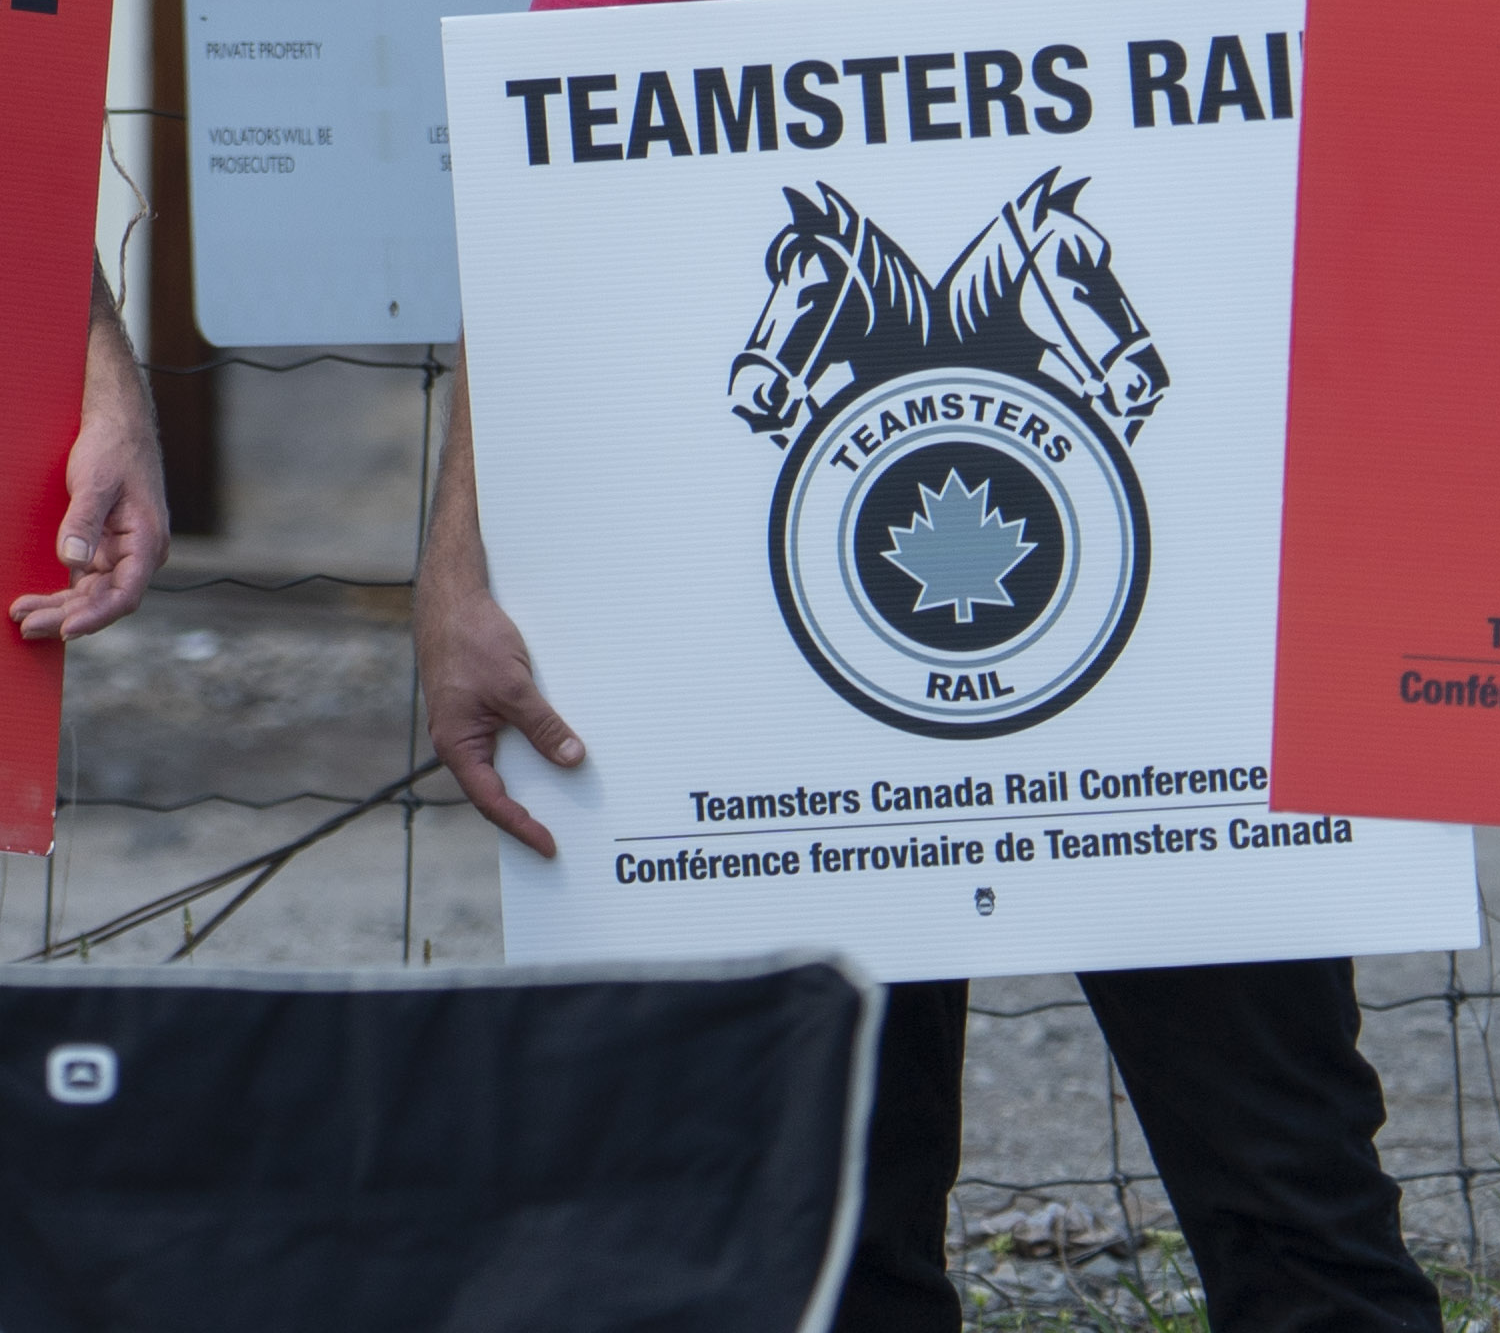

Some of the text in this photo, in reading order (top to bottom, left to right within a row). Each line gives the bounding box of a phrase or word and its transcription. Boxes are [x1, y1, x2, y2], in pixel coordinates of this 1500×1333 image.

[206, 41, 322, 60] PRIVATE PROPERTY
[505, 30, 1306, 166] TEAMSTERS RAI
[209, 128, 333, 146] VIOLATORS WILL BE
[210, 156, 295, 174] PROSECUTED
[829, 392, 1072, 476] TEAMSTERS
[926, 670, 1014, 703] RAIL
[690, 765, 1268, 822] Teamsters Canada Rail Conference
[615, 815, 1352, 884] Conférence ferroviaire de Teamsters Canada
